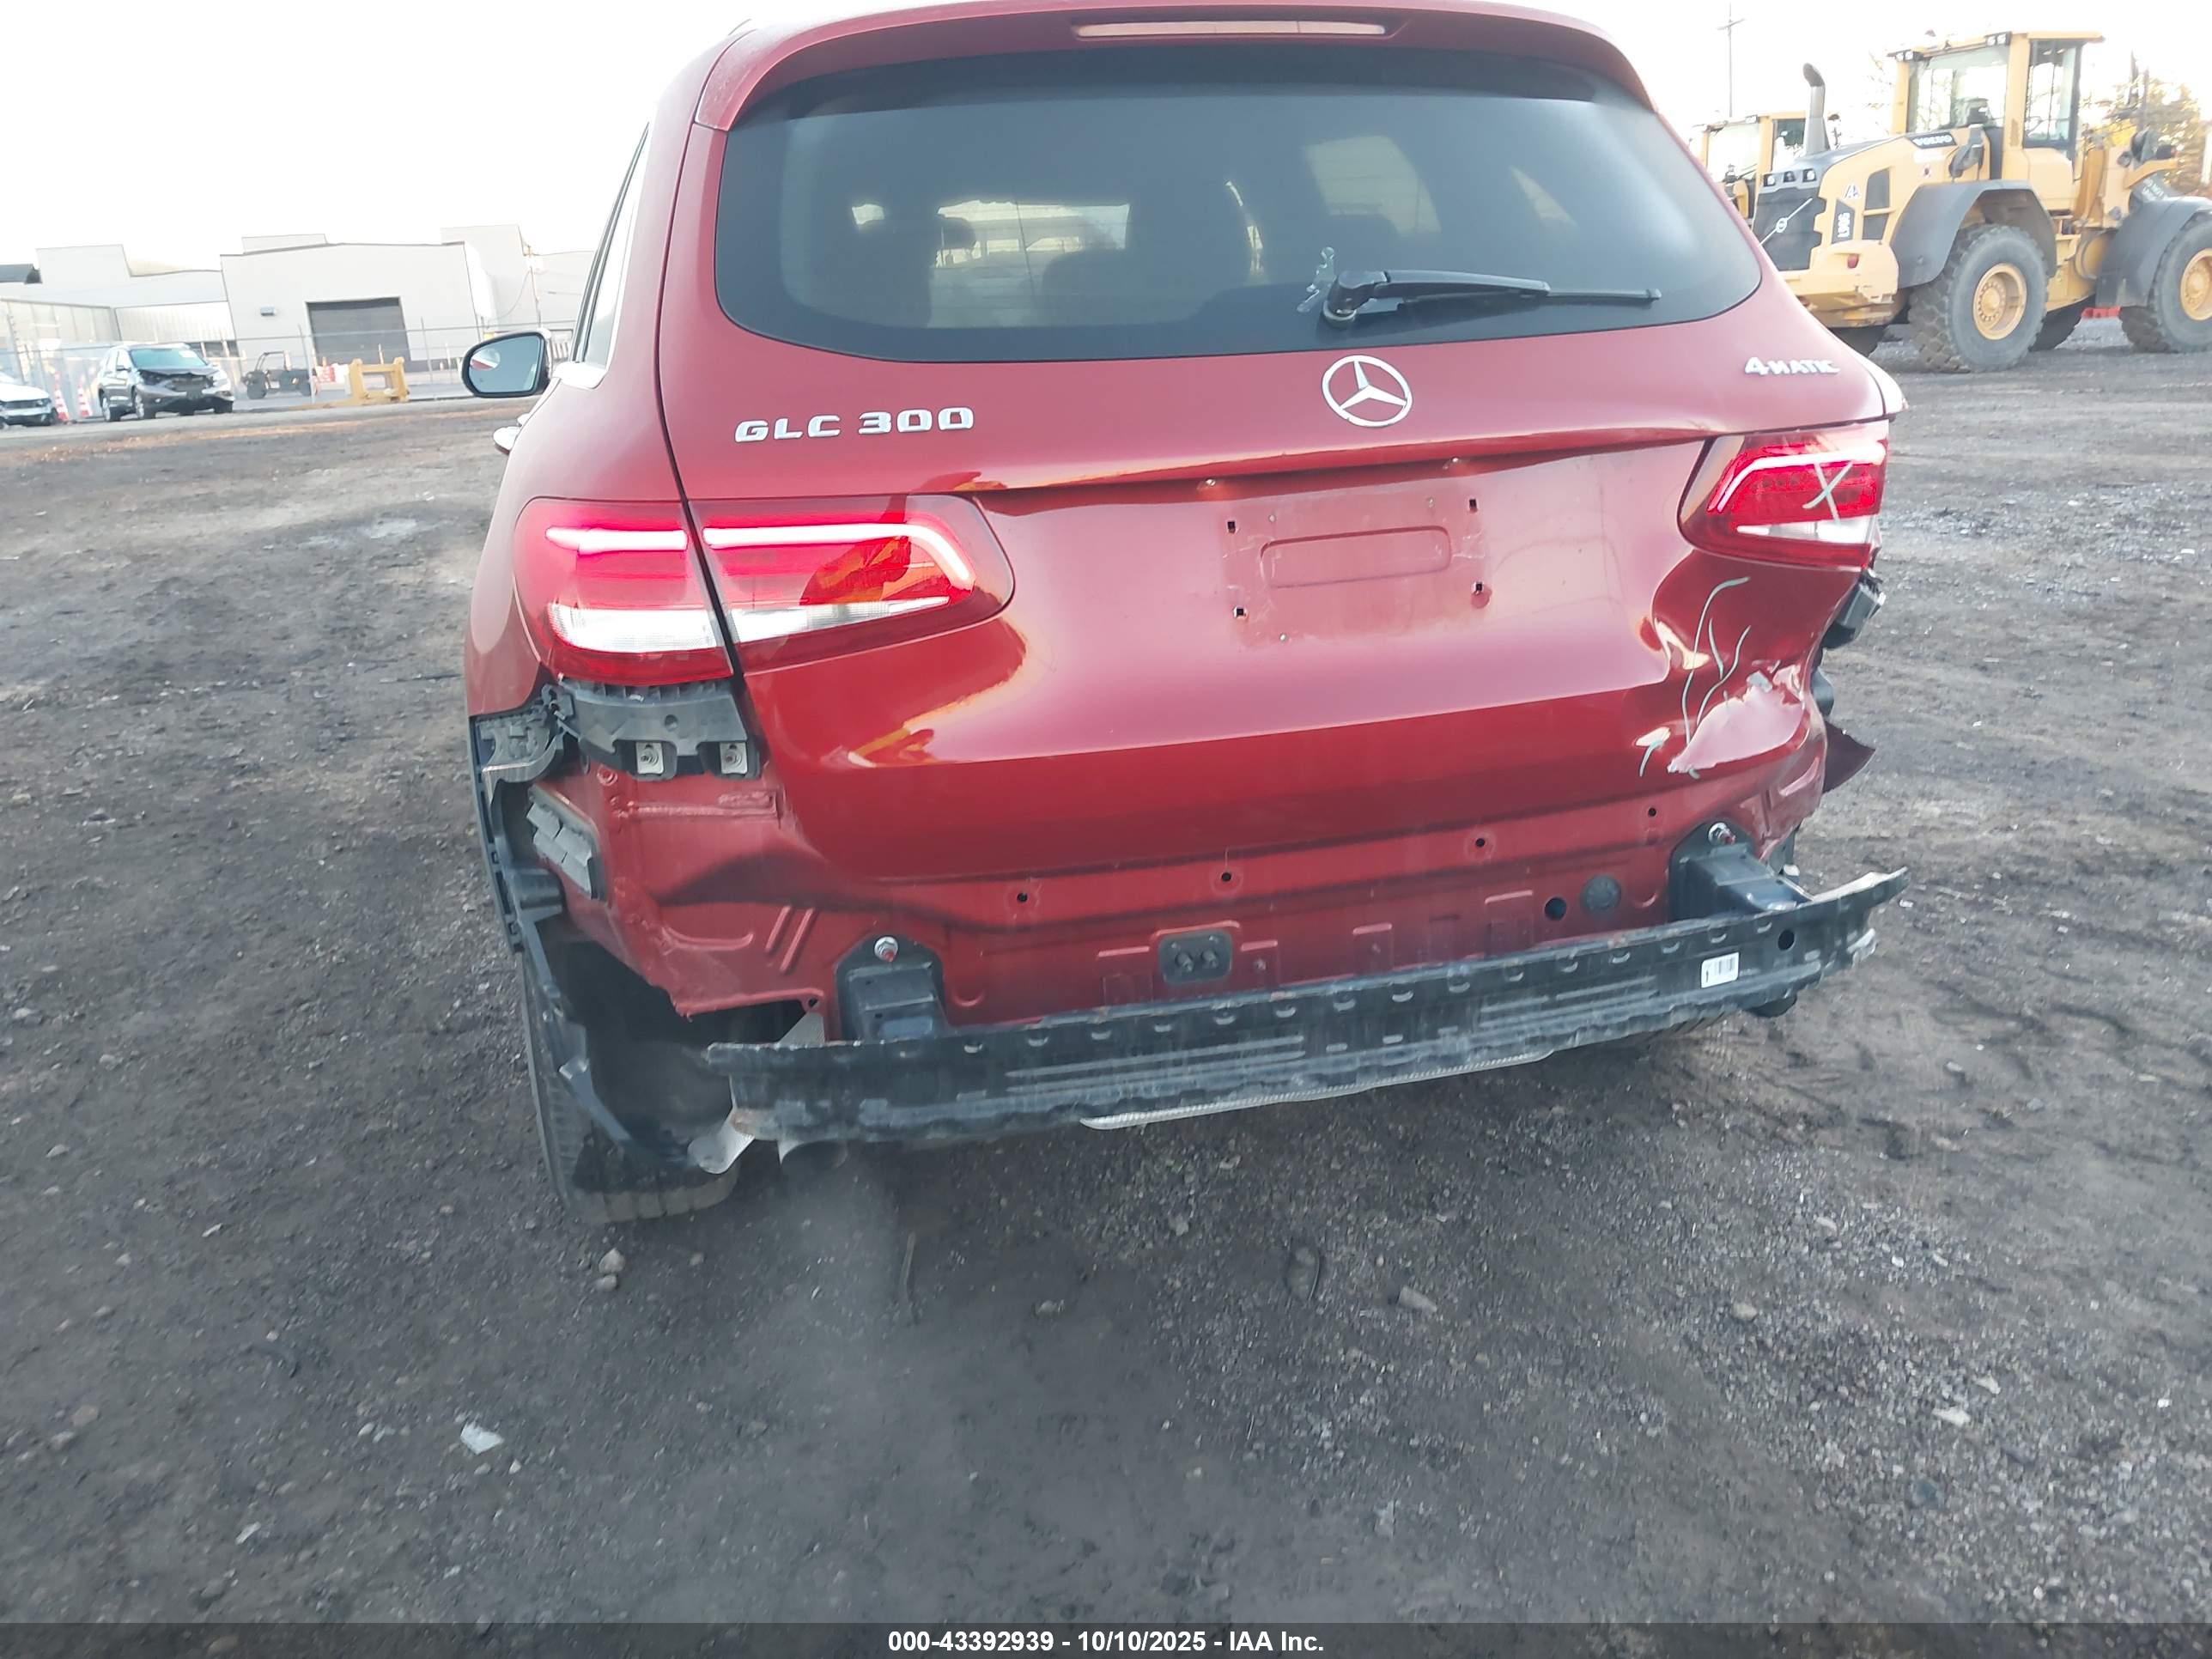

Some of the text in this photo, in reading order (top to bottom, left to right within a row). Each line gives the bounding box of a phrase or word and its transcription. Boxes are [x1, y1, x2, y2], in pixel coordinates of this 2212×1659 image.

[1912, 135, 1953, 146] VOLVO
[734, 407, 975, 442] GLC 300
